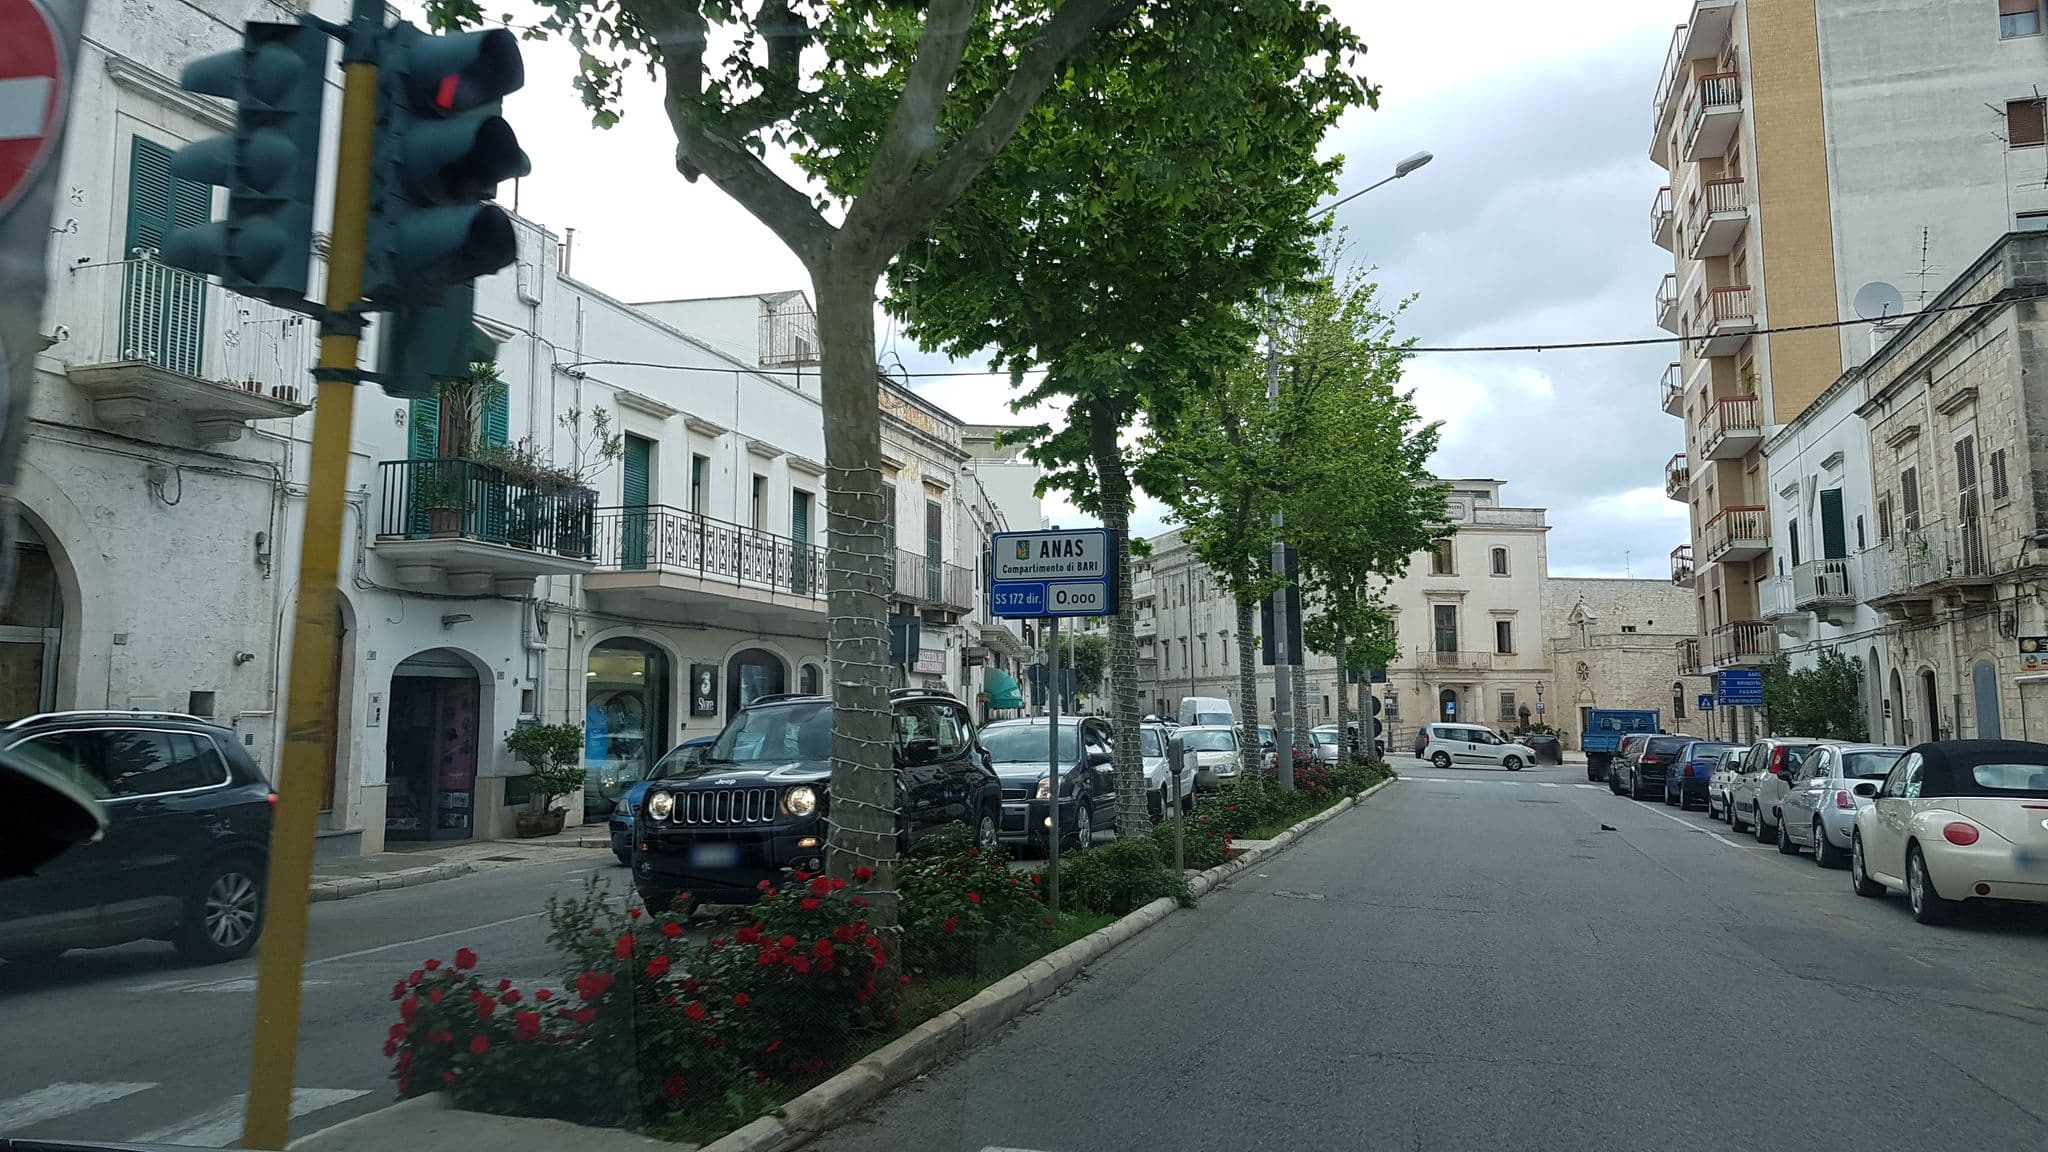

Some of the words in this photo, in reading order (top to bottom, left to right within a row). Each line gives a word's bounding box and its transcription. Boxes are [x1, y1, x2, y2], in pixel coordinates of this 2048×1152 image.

[1040, 539, 1084, 558] ANAS
[1002, 563, 1064, 575] Compartimento
[1066, 561, 1075, 572] di
[1077, 561, 1098, 571] BARI
[995, 595, 1007, 604] SS
[1009, 593, 1024, 604] 172
[1026, 592, 1042, 604] dir.
[701, 671, 711, 695] 3
[698, 697, 714, 711] Store
